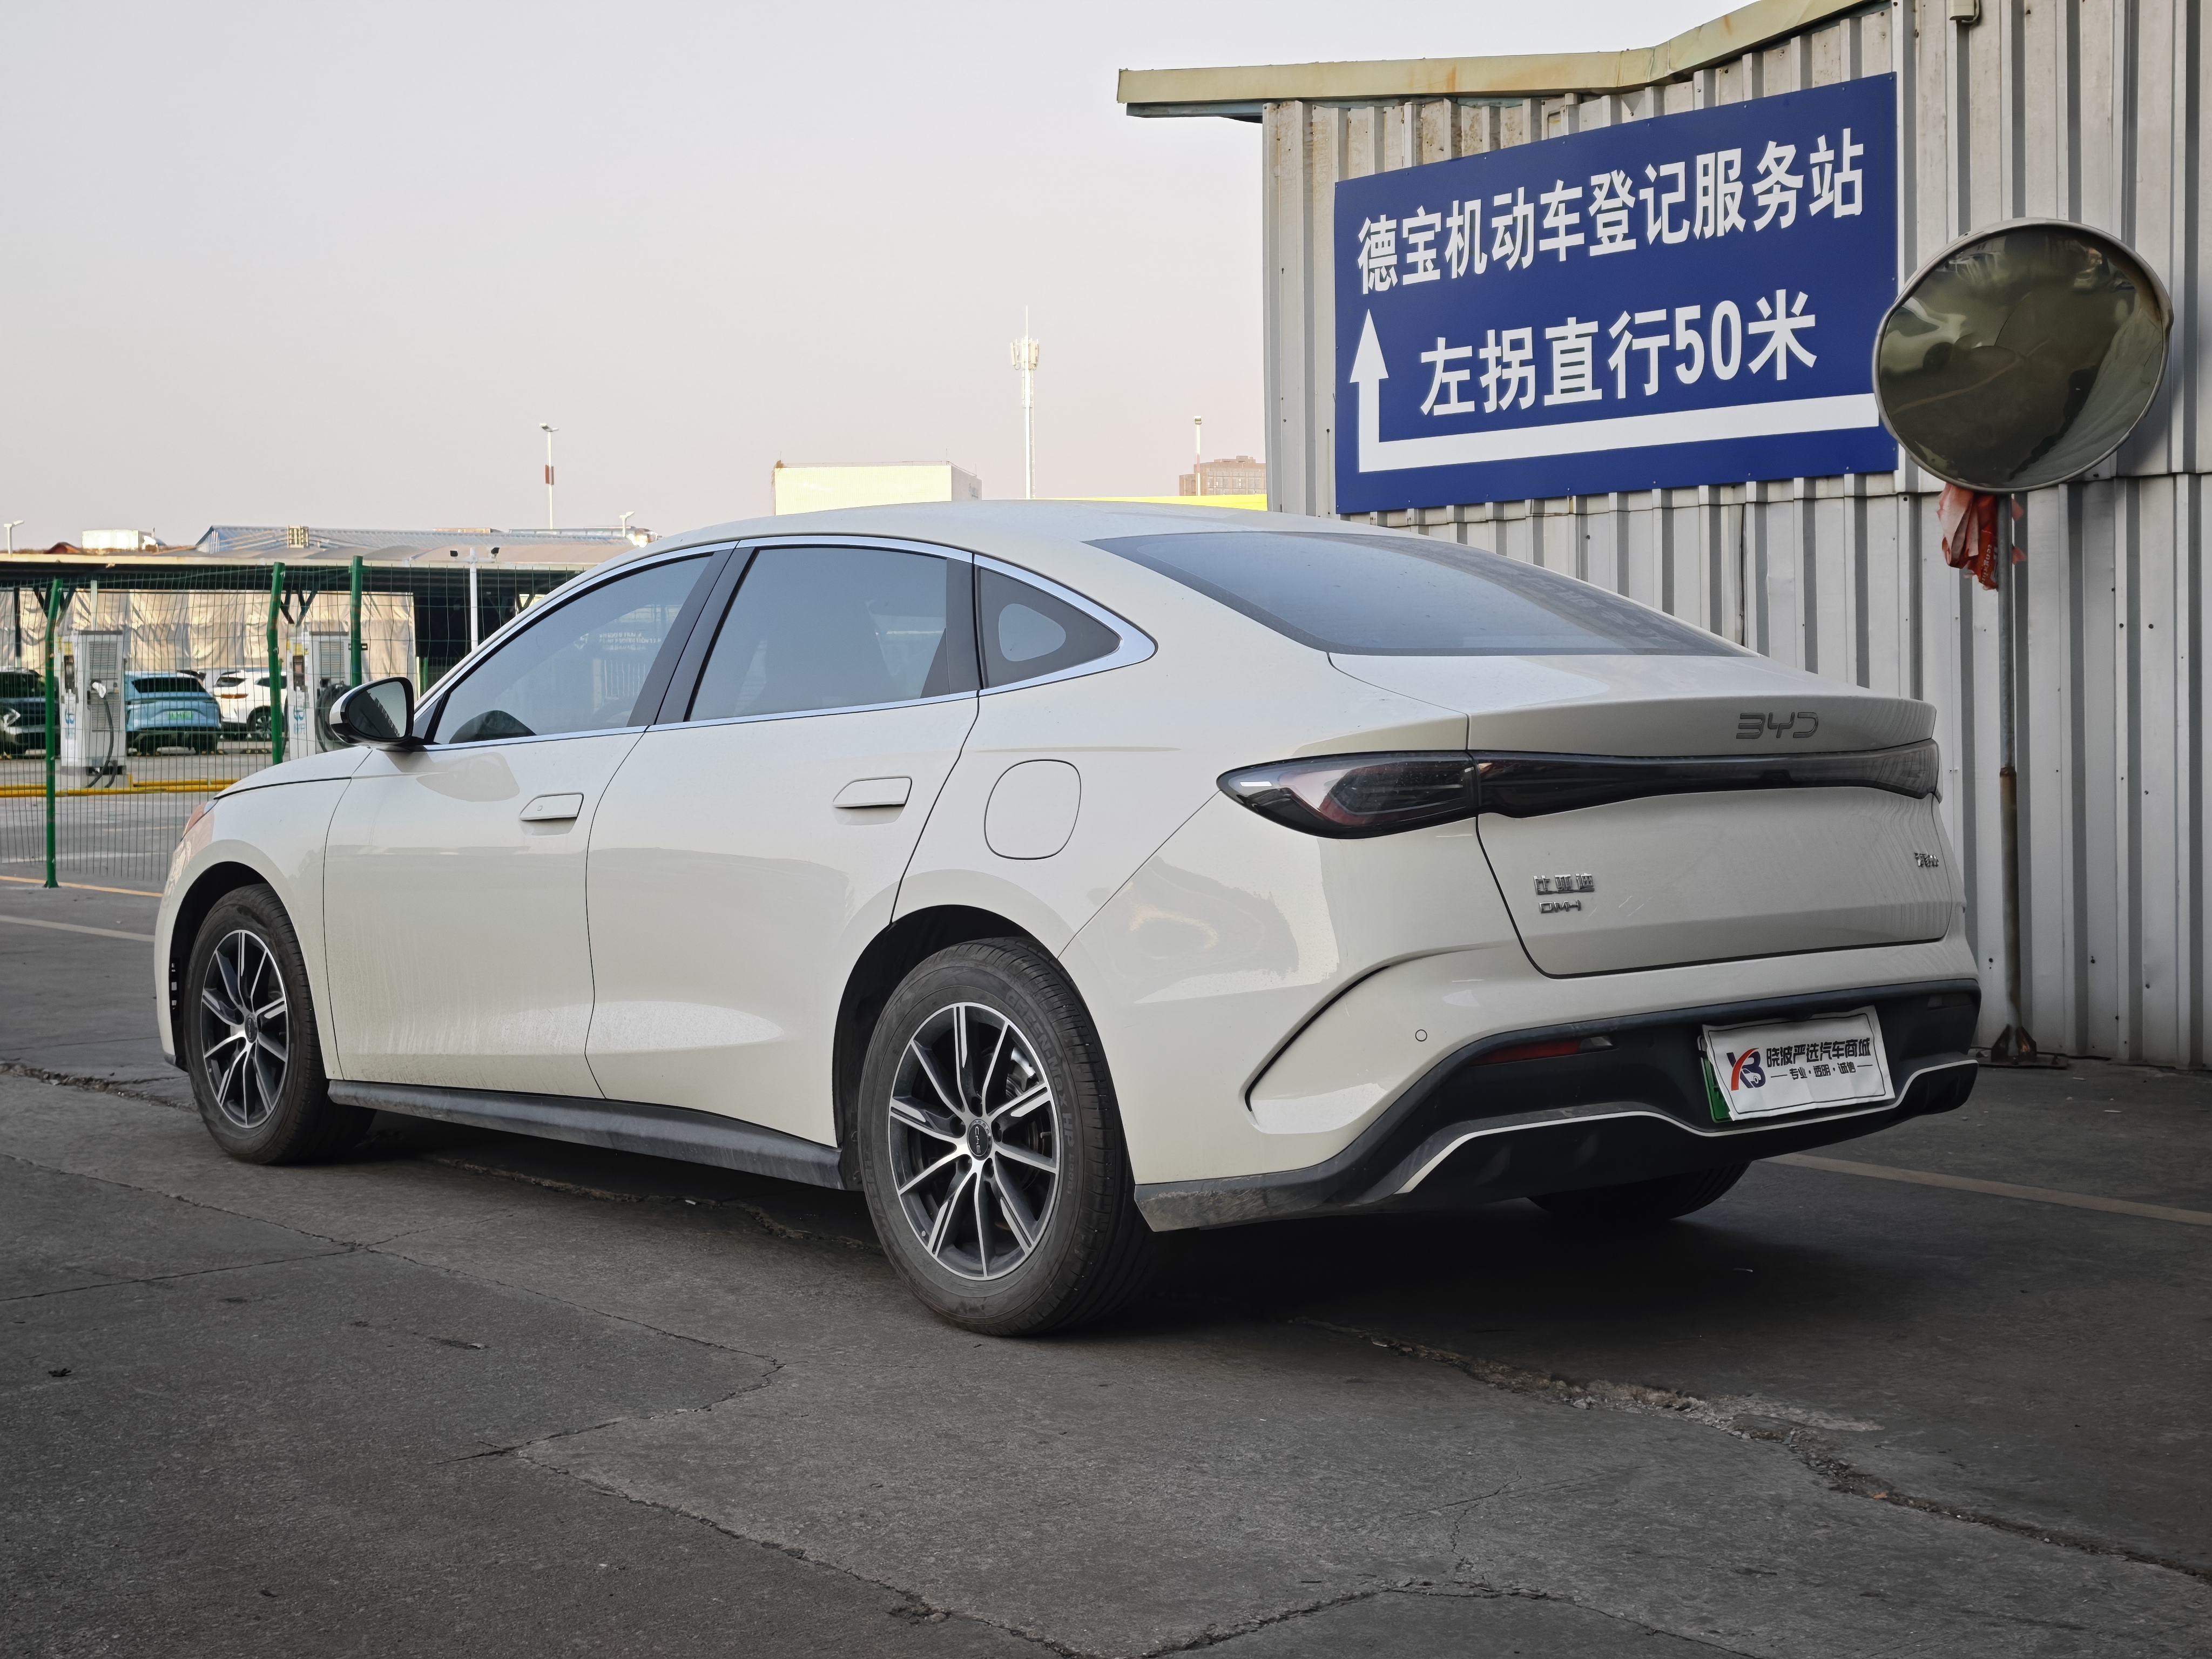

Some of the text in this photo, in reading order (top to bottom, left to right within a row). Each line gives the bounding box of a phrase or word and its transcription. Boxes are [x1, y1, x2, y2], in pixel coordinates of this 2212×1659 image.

[1357, 129, 1864, 294] 德宝机动车登记服务站
[1420, 288, 1817, 416] 左拐直行50米
[1736, 712, 1819, 739] BYD
[1766, 1037, 1871, 1067] 晓波严选汽车商城
[1062, 1112, 1075, 1147] HP
